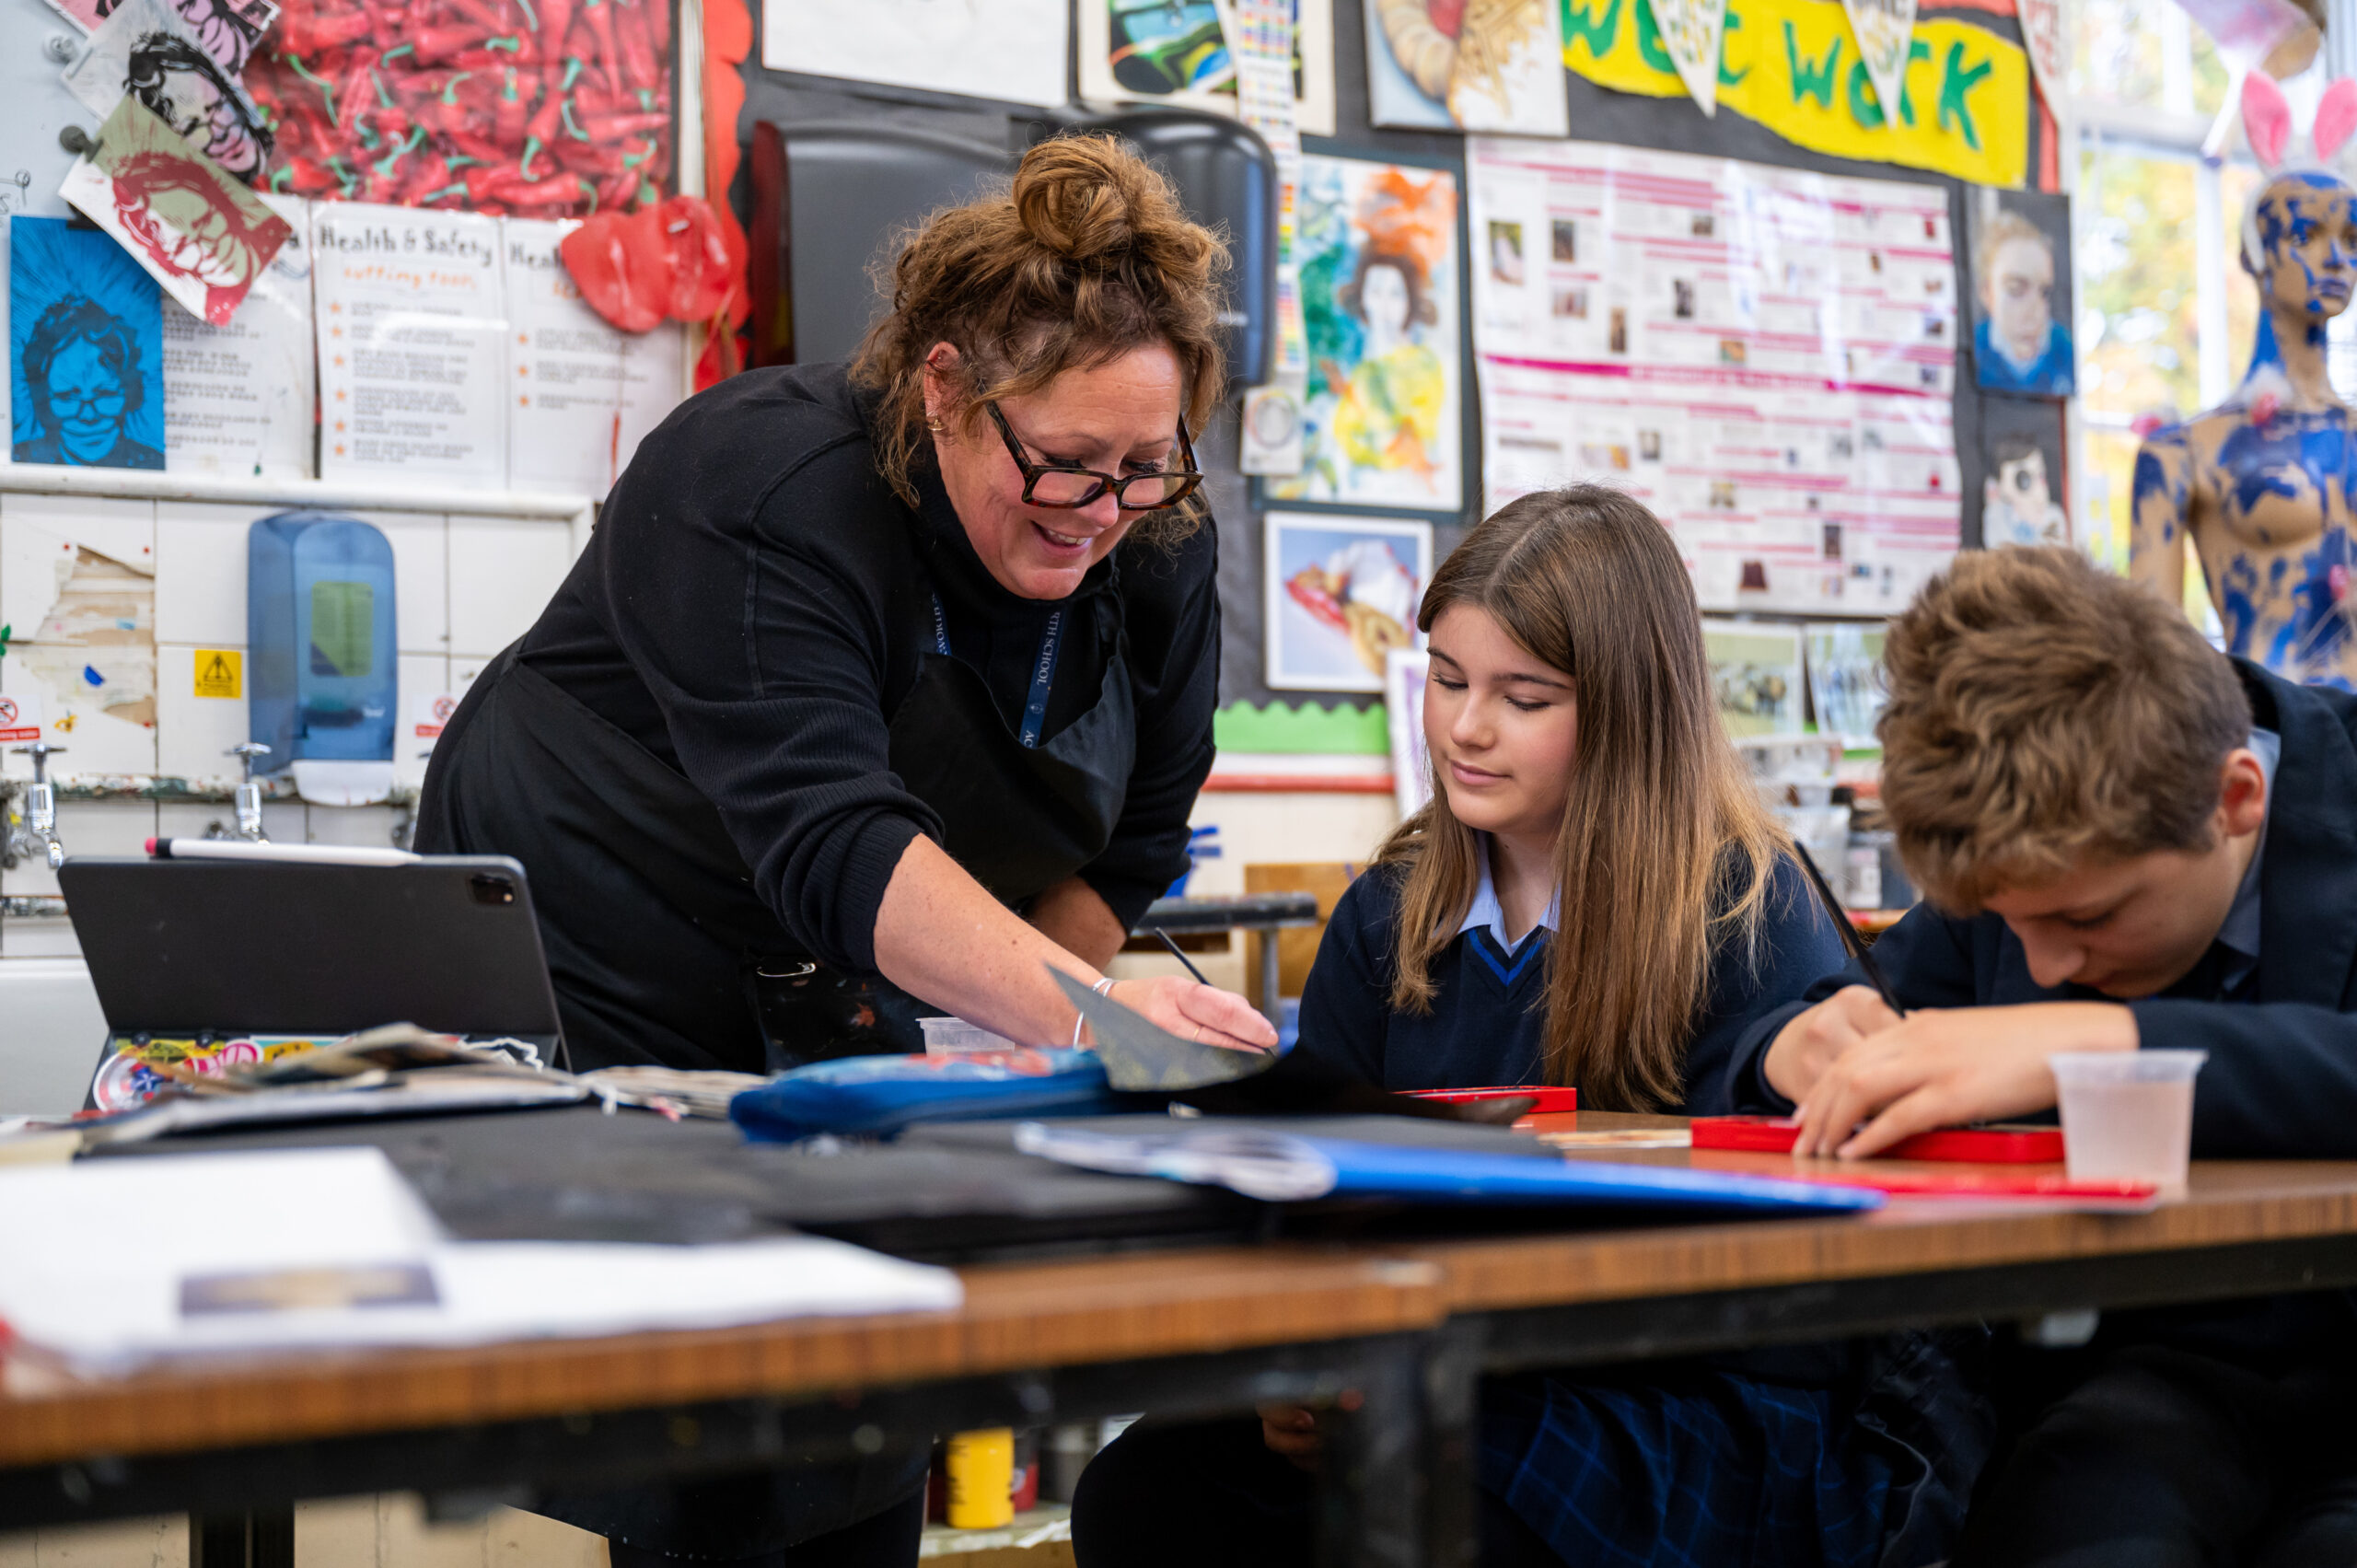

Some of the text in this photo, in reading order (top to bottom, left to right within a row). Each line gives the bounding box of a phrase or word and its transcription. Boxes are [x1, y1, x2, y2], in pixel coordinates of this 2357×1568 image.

[319, 225, 396, 253] Health
[424, 227, 493, 268] Safety
[1037, 637, 1056, 686] SCHOOL
